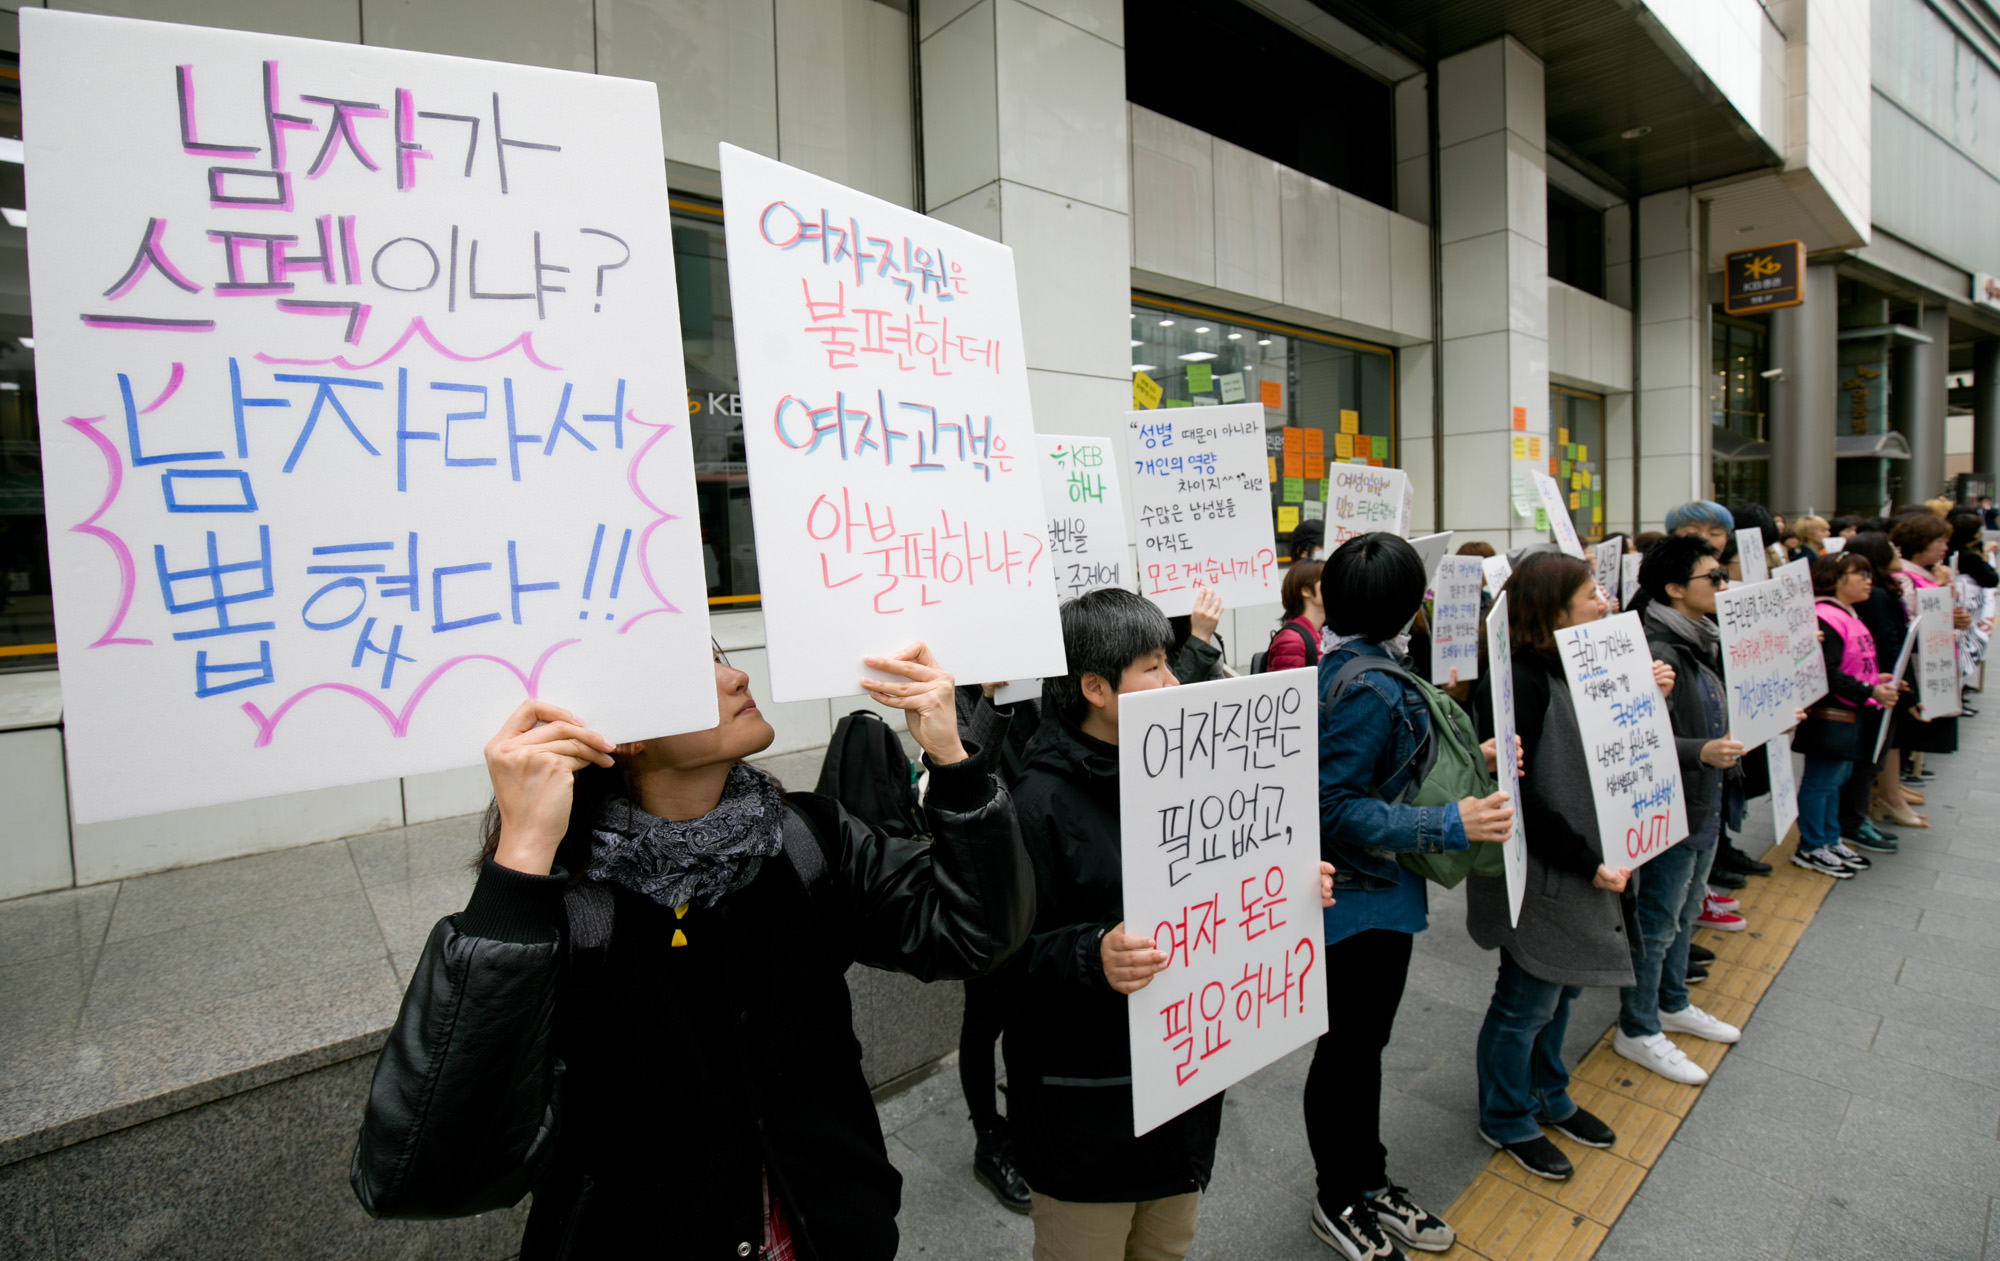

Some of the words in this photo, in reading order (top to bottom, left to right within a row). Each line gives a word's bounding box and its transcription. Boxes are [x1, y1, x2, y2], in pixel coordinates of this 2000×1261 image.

[175, 60, 561, 212] 남자가
[79, 215, 631, 346] 스펙이냐?
[759, 201, 968, 304] 여자직원은
[803, 278, 1000, 376] 불편한데
[117, 357, 627, 513] 남자라서
[774, 389, 1015, 482] 여자고객은
[1072, 445, 1104, 467] KEB
[1135, 456, 1184, 476] 개인의
[1188, 452, 1218, 475] 역량
[1181, 427, 1217, 444] 때문이
[1222, 420, 1260, 437] 아니라
[1066, 471, 1107, 503] 하나
[1140, 503, 1184, 527] 수많은
[1189, 498, 1236, 520] 남성분들
[807, 487, 1044, 614] 안불편하냐?
[1067, 562, 1119, 595] 주제에
[1146, 533, 1194, 553] 아직도
[1148, 548, 1274, 595] 모르겠습니까?
[1568, 639, 1602, 675] 국민
[1143, 687, 1301, 778] 여자직원은
[1157, 783, 1293, 887] 필요없고,
[1627, 809, 1670, 860] OUT!
[1153, 892, 1227, 967] 여자
[1239, 866, 1288, 942] 돈은
[1160, 937, 1315, 1086] 필요하냐?
